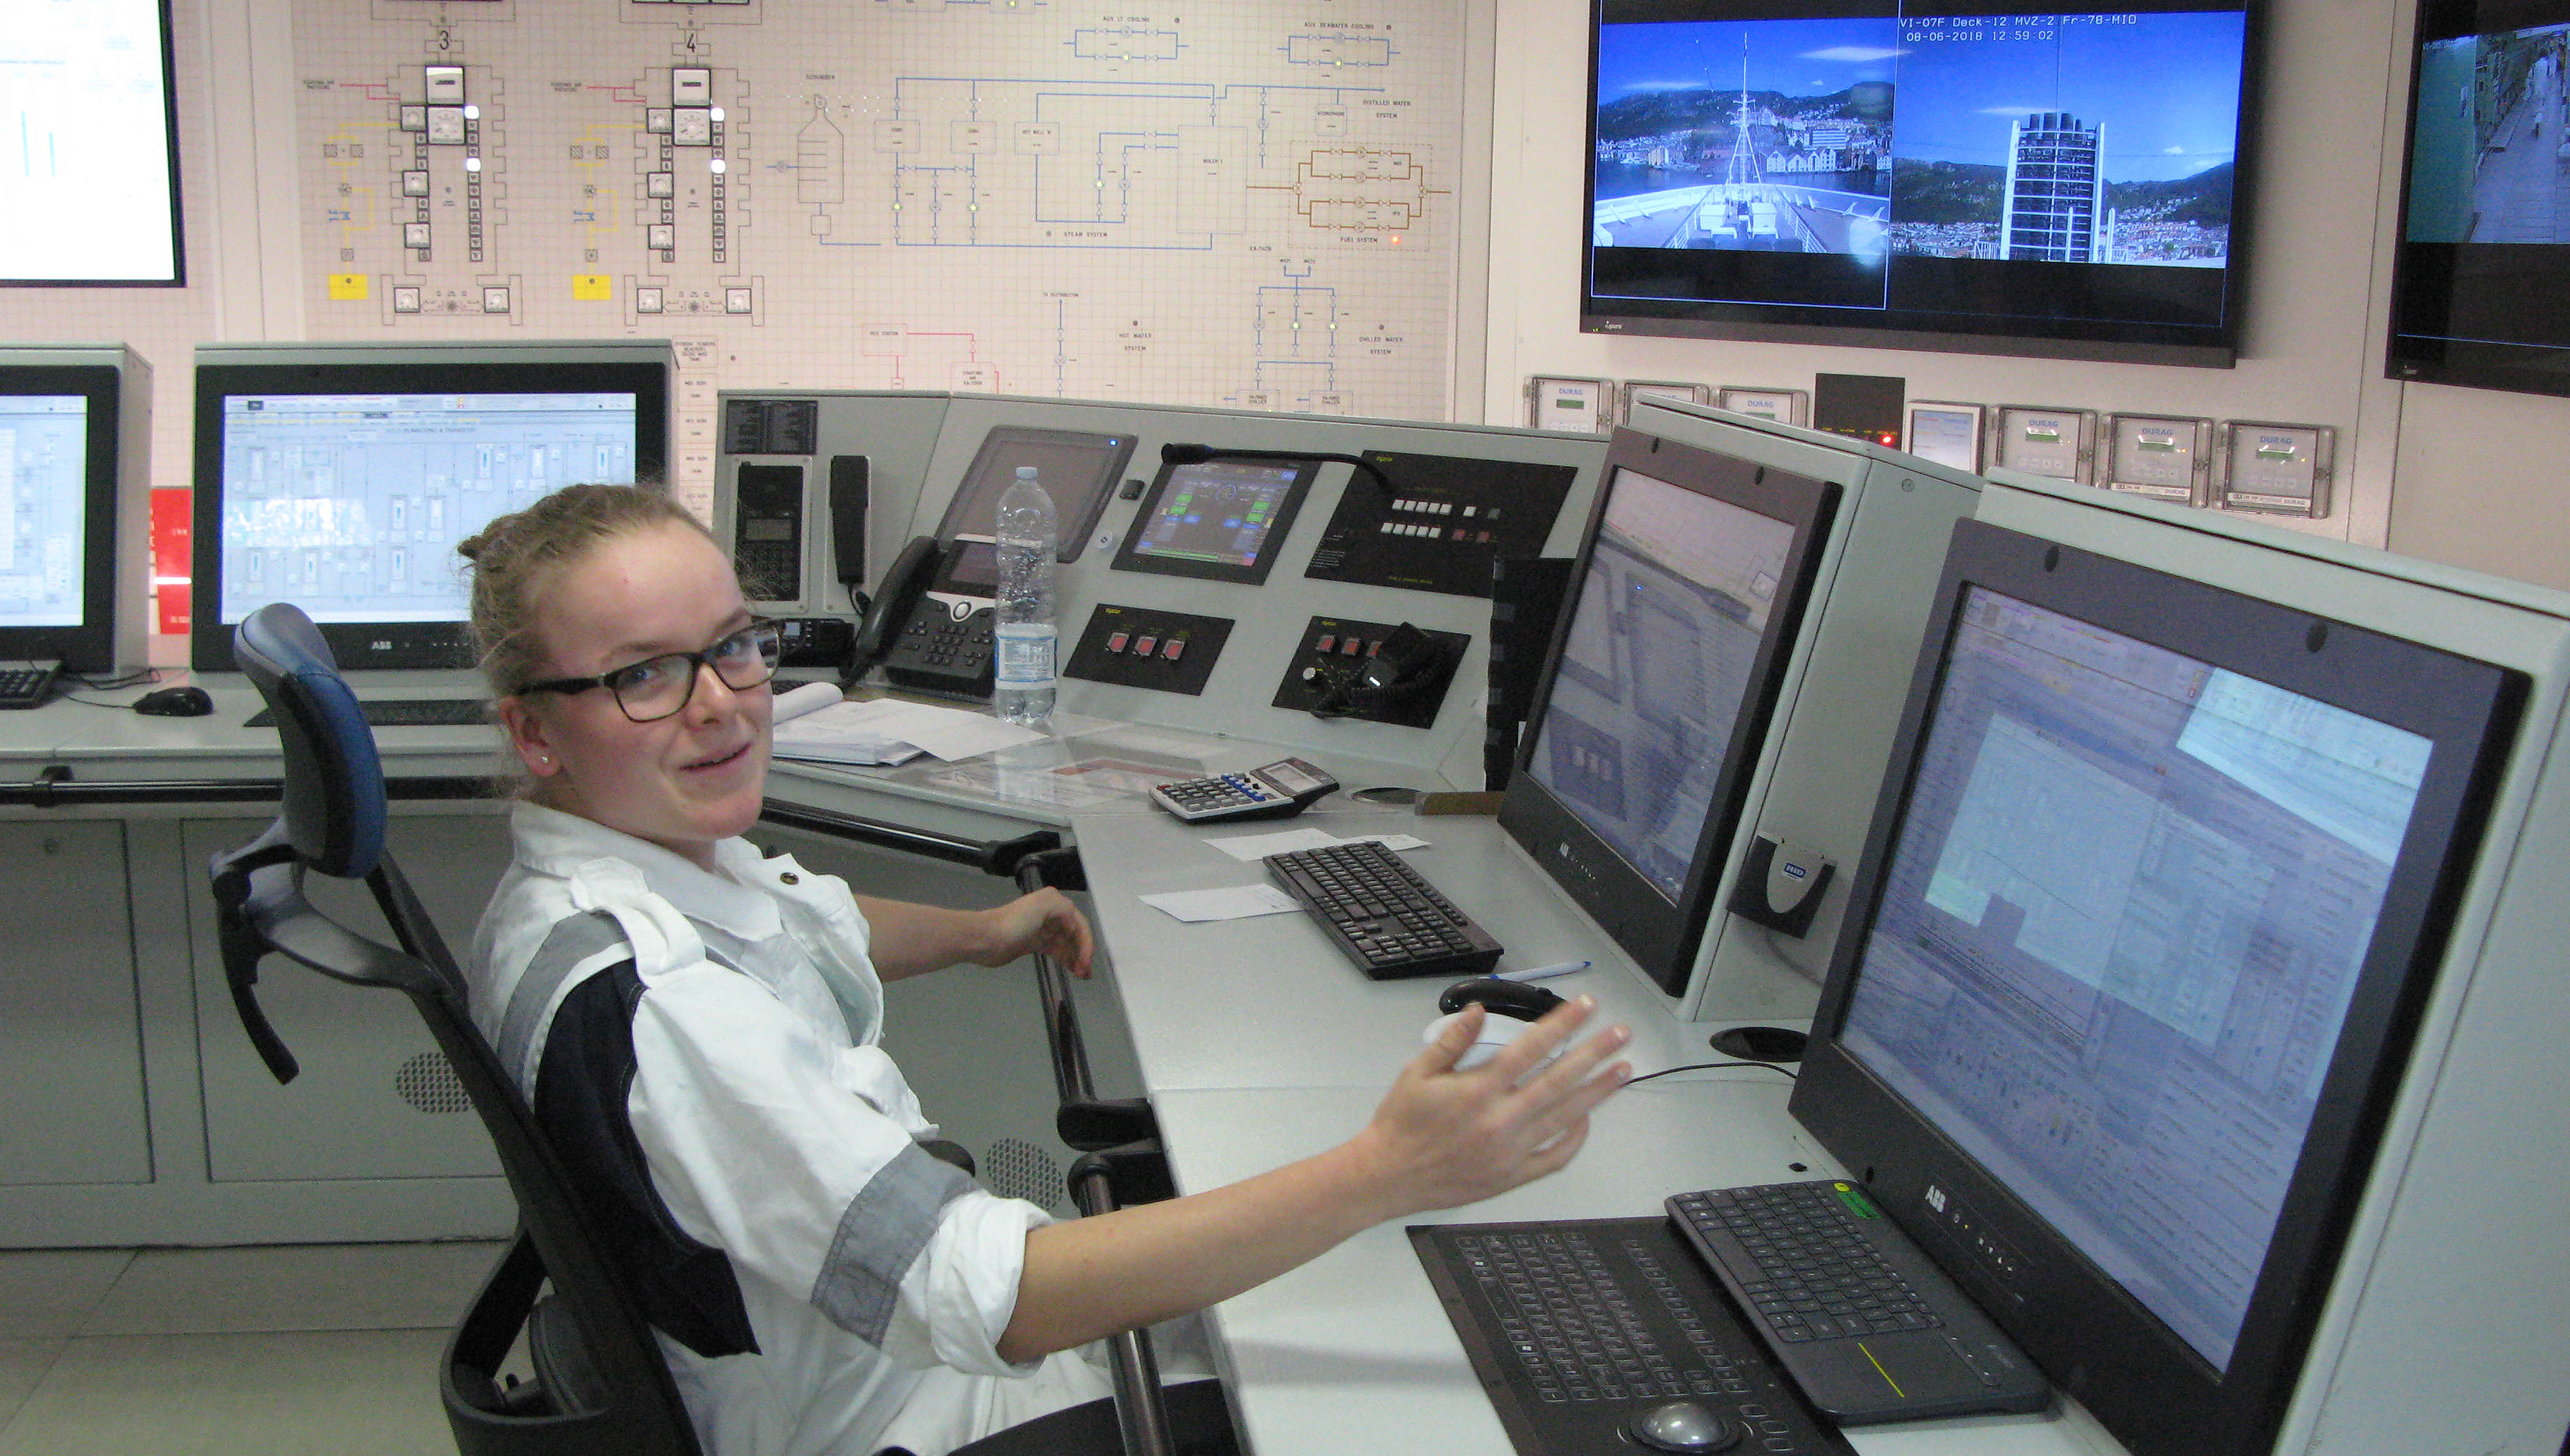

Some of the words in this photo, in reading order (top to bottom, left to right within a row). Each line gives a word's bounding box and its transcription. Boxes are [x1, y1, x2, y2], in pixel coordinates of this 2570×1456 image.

[2063, 15, 2137, 26] Fr-78-MID
[440, 31, 449, 50] 3
[1906, 31, 1982, 42] 08-06-2018
[1992, 31, 2053, 41] 12:59:02
[687, 33, 696, 53] 4
[2260, 435, 2293, 445] DURAG
[372, 640, 392, 650] ABB
[1925, 1184, 1947, 1213] ABB
